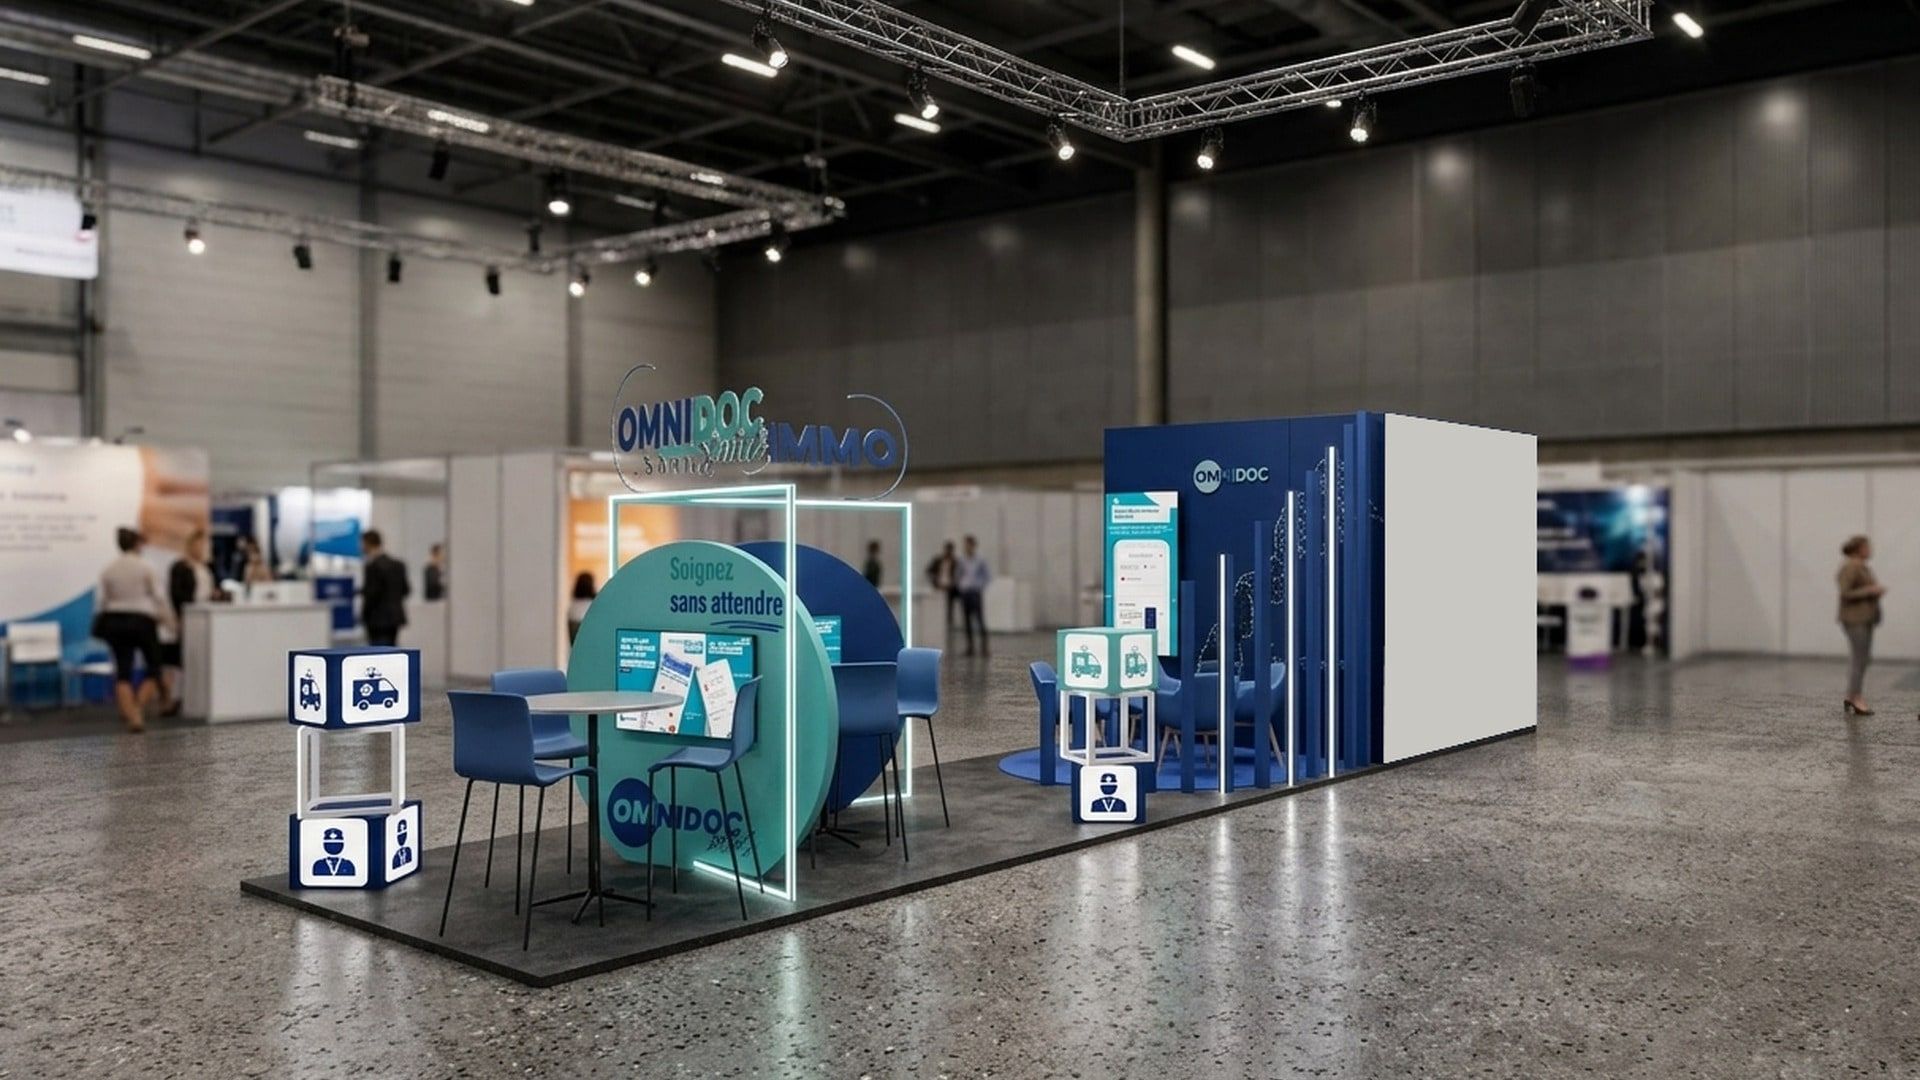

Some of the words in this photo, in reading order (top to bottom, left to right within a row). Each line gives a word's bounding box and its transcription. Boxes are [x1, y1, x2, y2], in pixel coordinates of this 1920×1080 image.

[618, 387, 764, 452] OMNIDOC
[769, 421, 897, 468] IMMO
[670, 557, 734, 586] Soignez
[670, 594, 707, 613] sans
[711, 589, 783, 616] attendre
[613, 798, 743, 837] OMNIDOC
